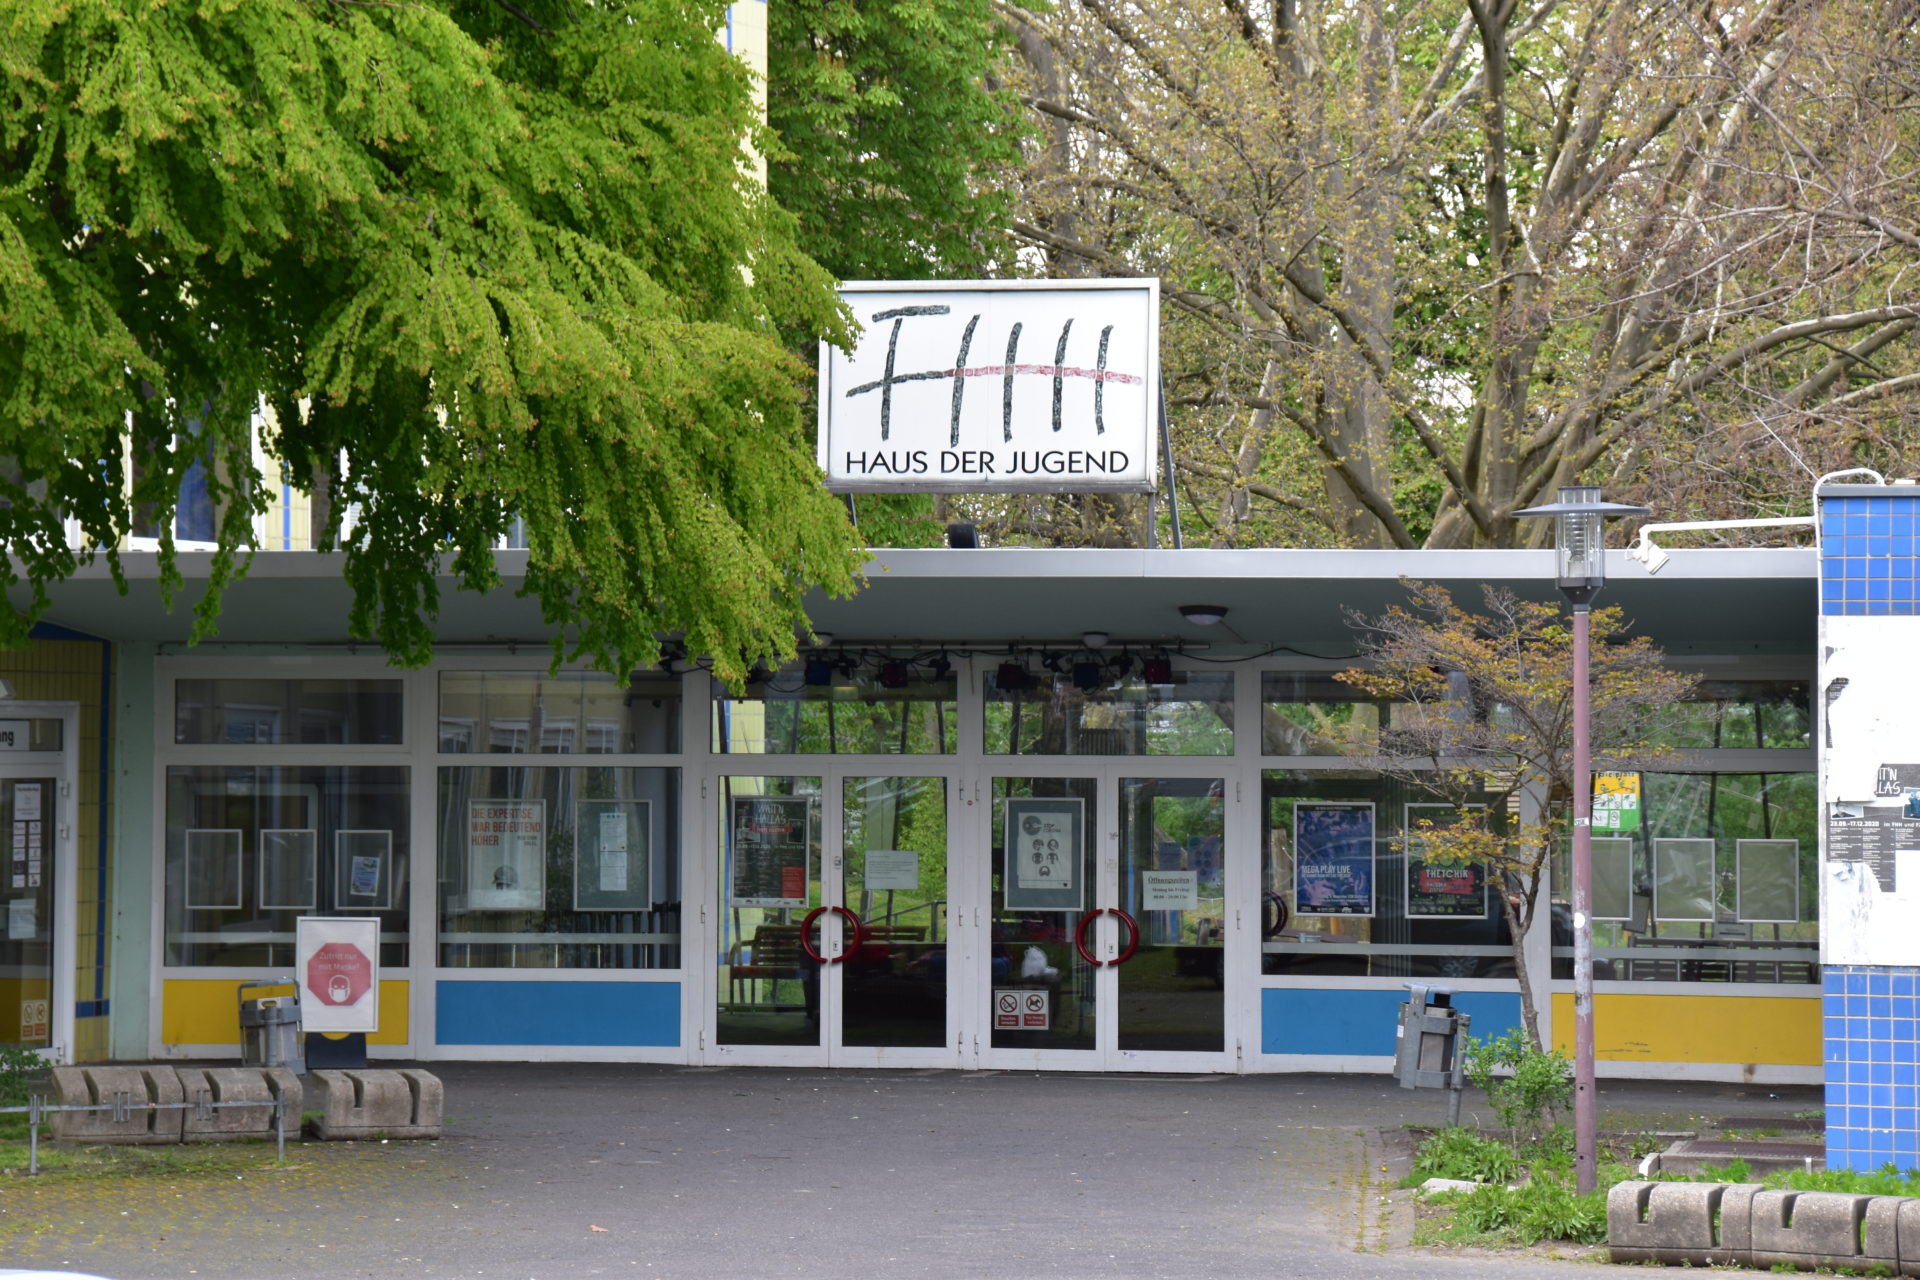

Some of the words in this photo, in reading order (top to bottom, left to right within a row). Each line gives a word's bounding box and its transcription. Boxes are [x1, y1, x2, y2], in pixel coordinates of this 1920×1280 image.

[846, 450, 928, 474] HAUS
[940, 450, 996, 474] DER
[1005, 450, 1129, 474] JUGEND
[471, 807, 485, 819] DIE
[487, 807, 533, 819] EXPERTISE
[471, 821, 490, 833] WAR
[492, 821, 541, 833] BEDEUTEND
[1301, 865, 1320, 874] MEGA
[1320, 865, 1336, 874] PLAY
[1336, 865, 1352, 874] LIVE
